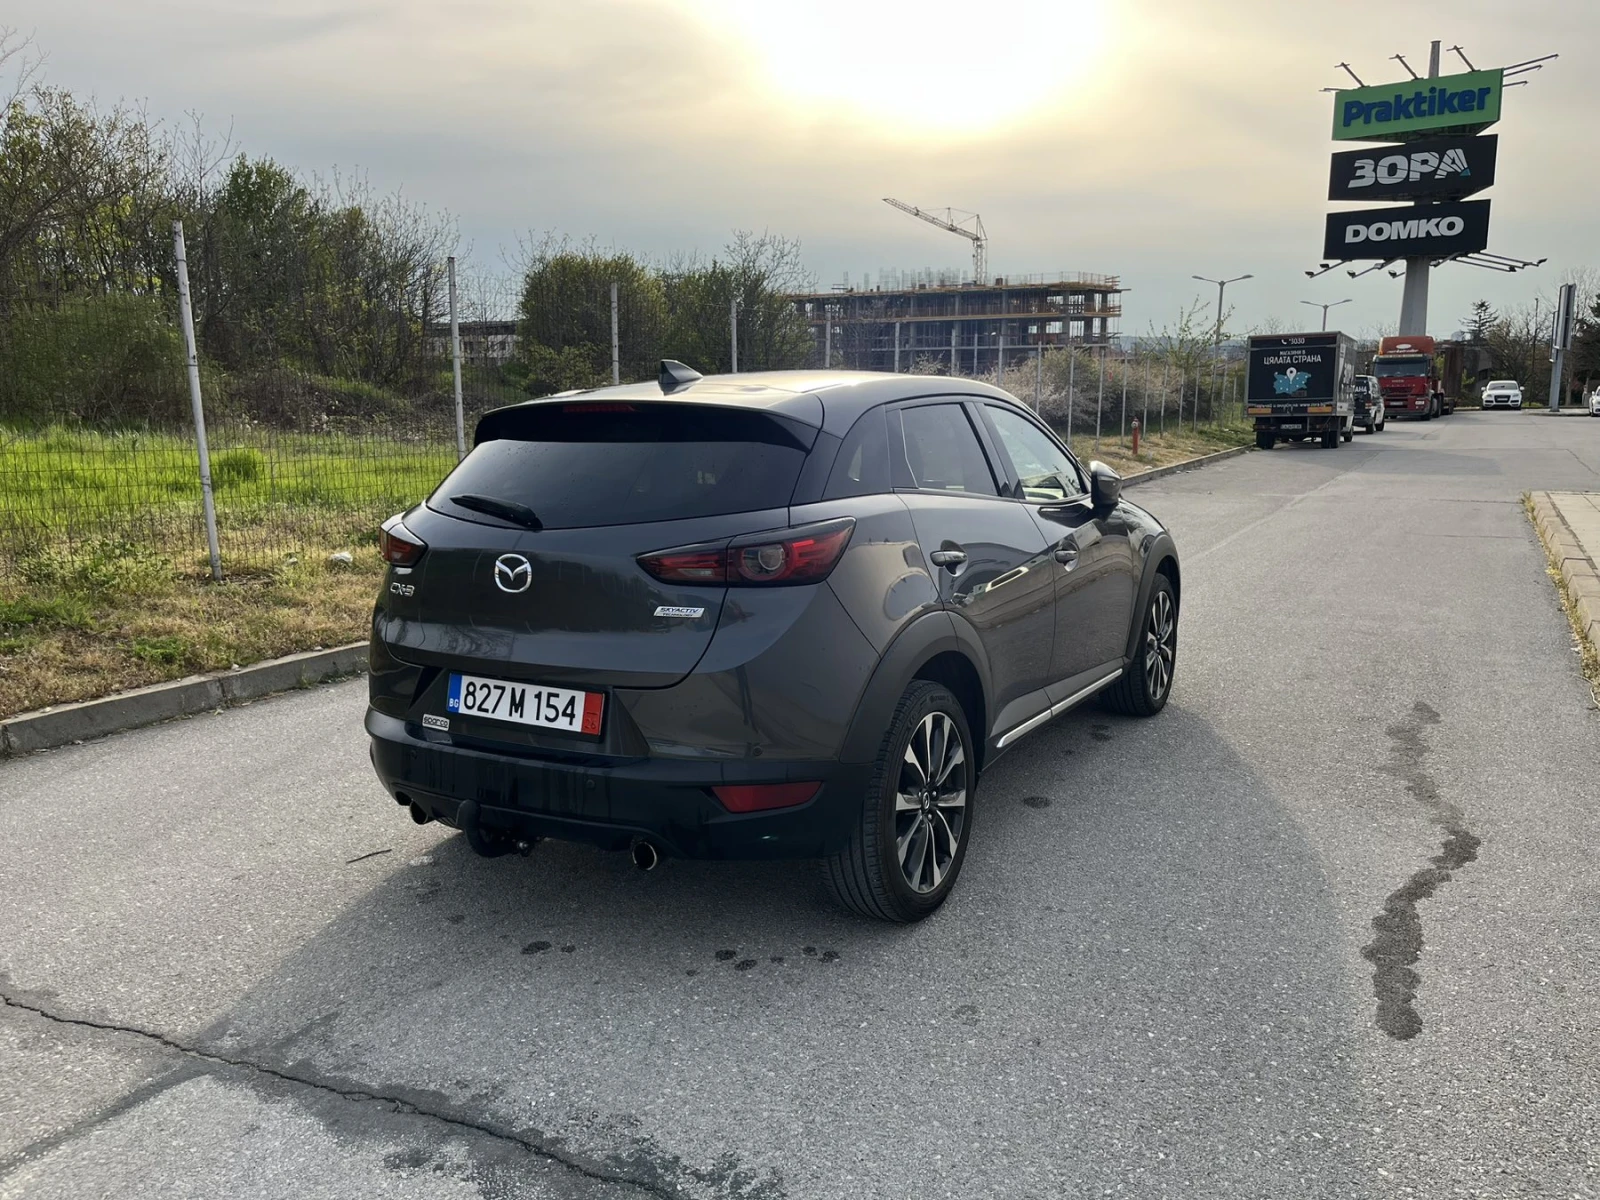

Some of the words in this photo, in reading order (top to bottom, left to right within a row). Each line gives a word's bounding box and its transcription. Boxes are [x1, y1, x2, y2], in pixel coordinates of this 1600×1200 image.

[1342, 86, 1491, 127] Praktiker
[1347, 148, 1471, 188] ЗОРА
[1345, 216, 1465, 243] DOMKO
[1263, 356, 1291, 365] ЦЯЛАТА
[1292, 354, 1322, 363] СТРАНА
[390, 582, 415, 597] CX-3
[449, 698, 459, 708] BG
[463, 681, 506, 714] 827
[508, 686, 526, 719] M
[534, 690, 576, 726] 154
[423, 716, 449, 728] sparco
